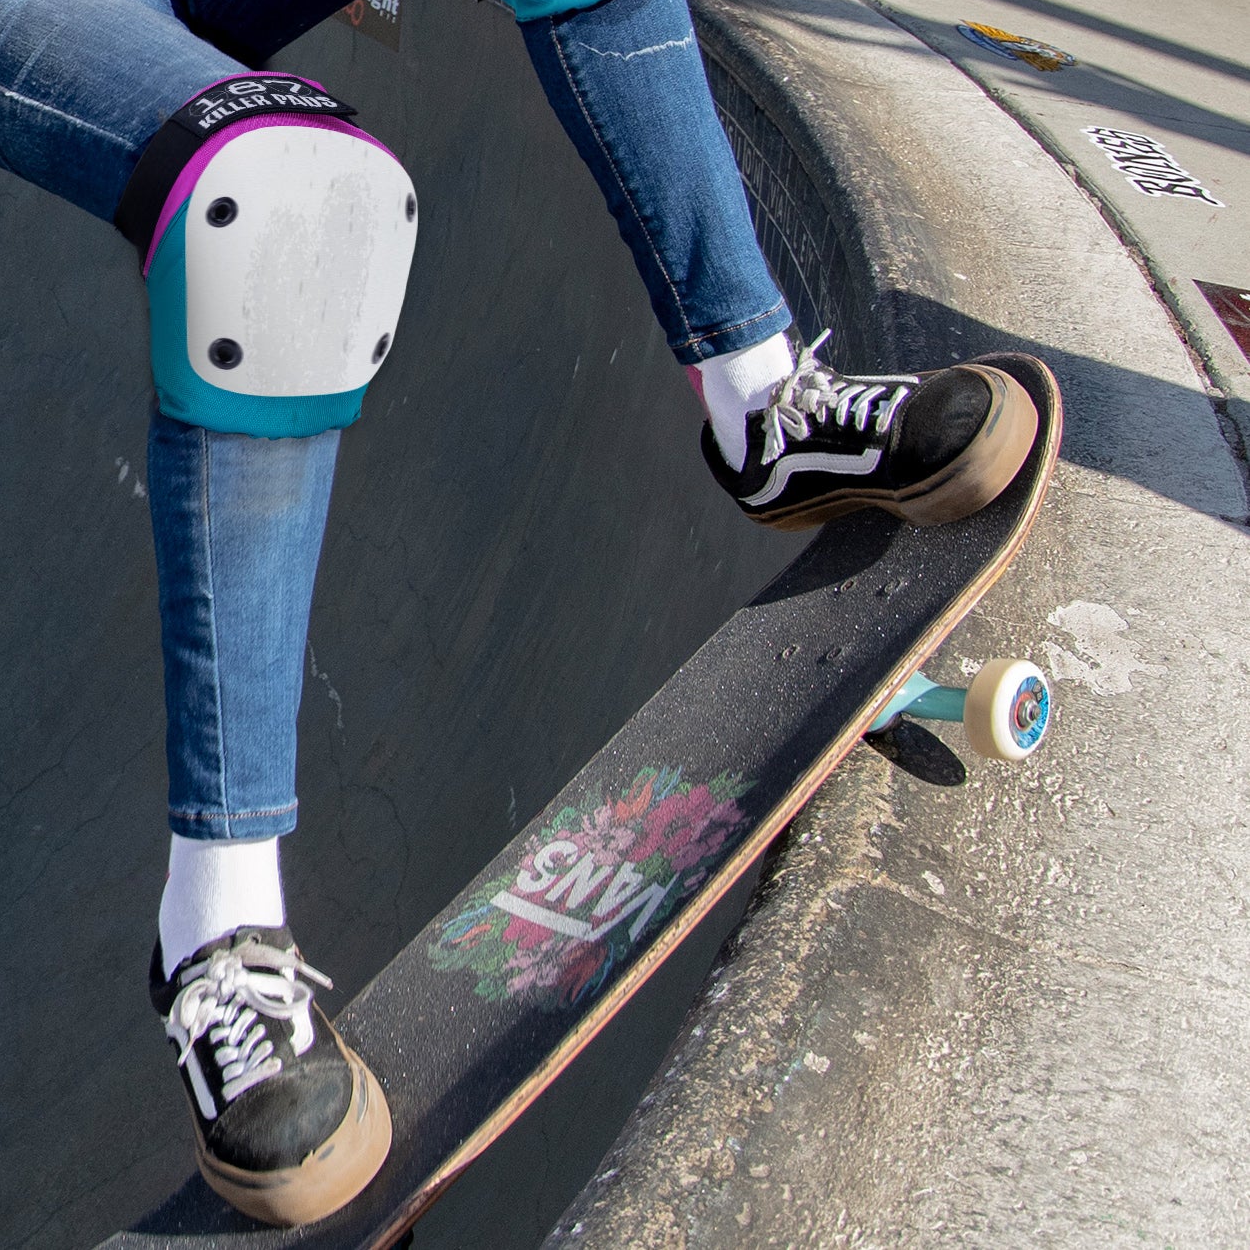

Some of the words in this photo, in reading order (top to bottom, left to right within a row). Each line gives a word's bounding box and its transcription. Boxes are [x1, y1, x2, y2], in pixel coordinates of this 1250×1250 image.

[196, 79, 303, 114] 187
[198, 95, 272, 130] KILLER
[272, 92, 338, 109] PADS
[490, 839, 681, 944] VANS
